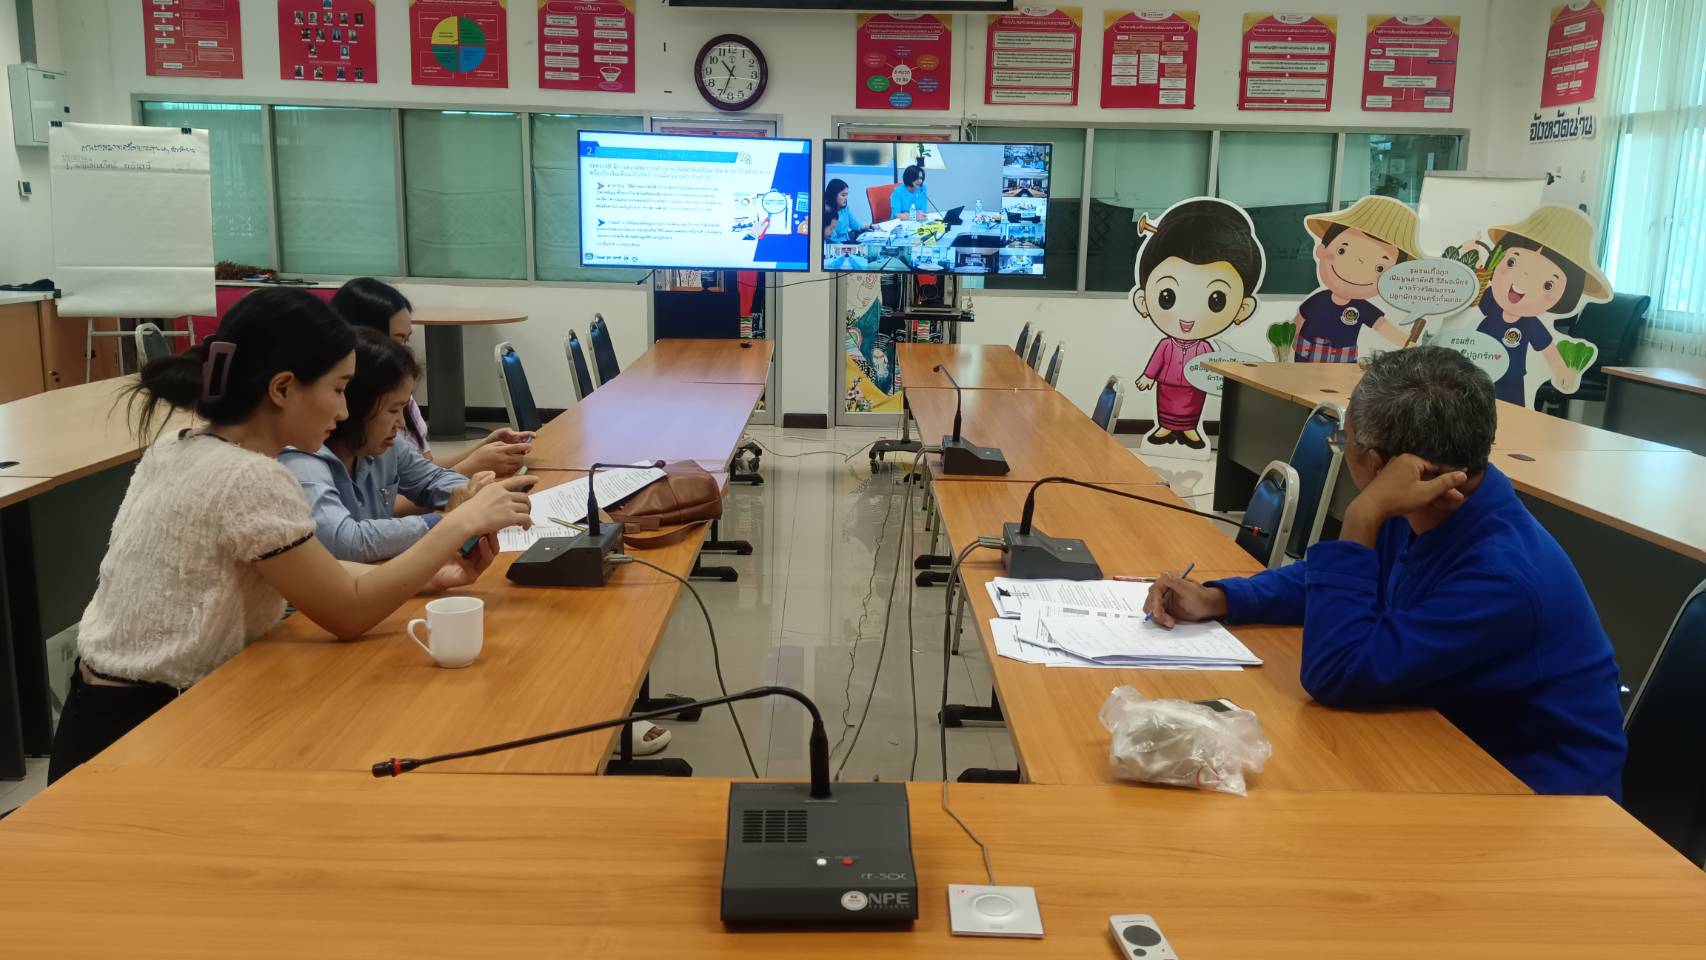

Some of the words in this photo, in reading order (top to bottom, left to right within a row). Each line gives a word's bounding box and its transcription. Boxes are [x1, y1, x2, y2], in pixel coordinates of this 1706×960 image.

[719, 48, 726, 57] 11
[742, 49, 746, 58] 1
[709, 56, 719, 65] 10
[748, 59, 755, 68] 2
[705, 66, 712, 76] 9
[750, 71, 758, 80] 3
[708, 78, 715, 88] 8
[746, 82, 753, 91] 4
[737, 90, 745, 99] 5
[1529, 106, 1593, 142] จังหวัดน่าน
[586, 146, 592, 156] 2
[868, 892, 910, 905] NPE
